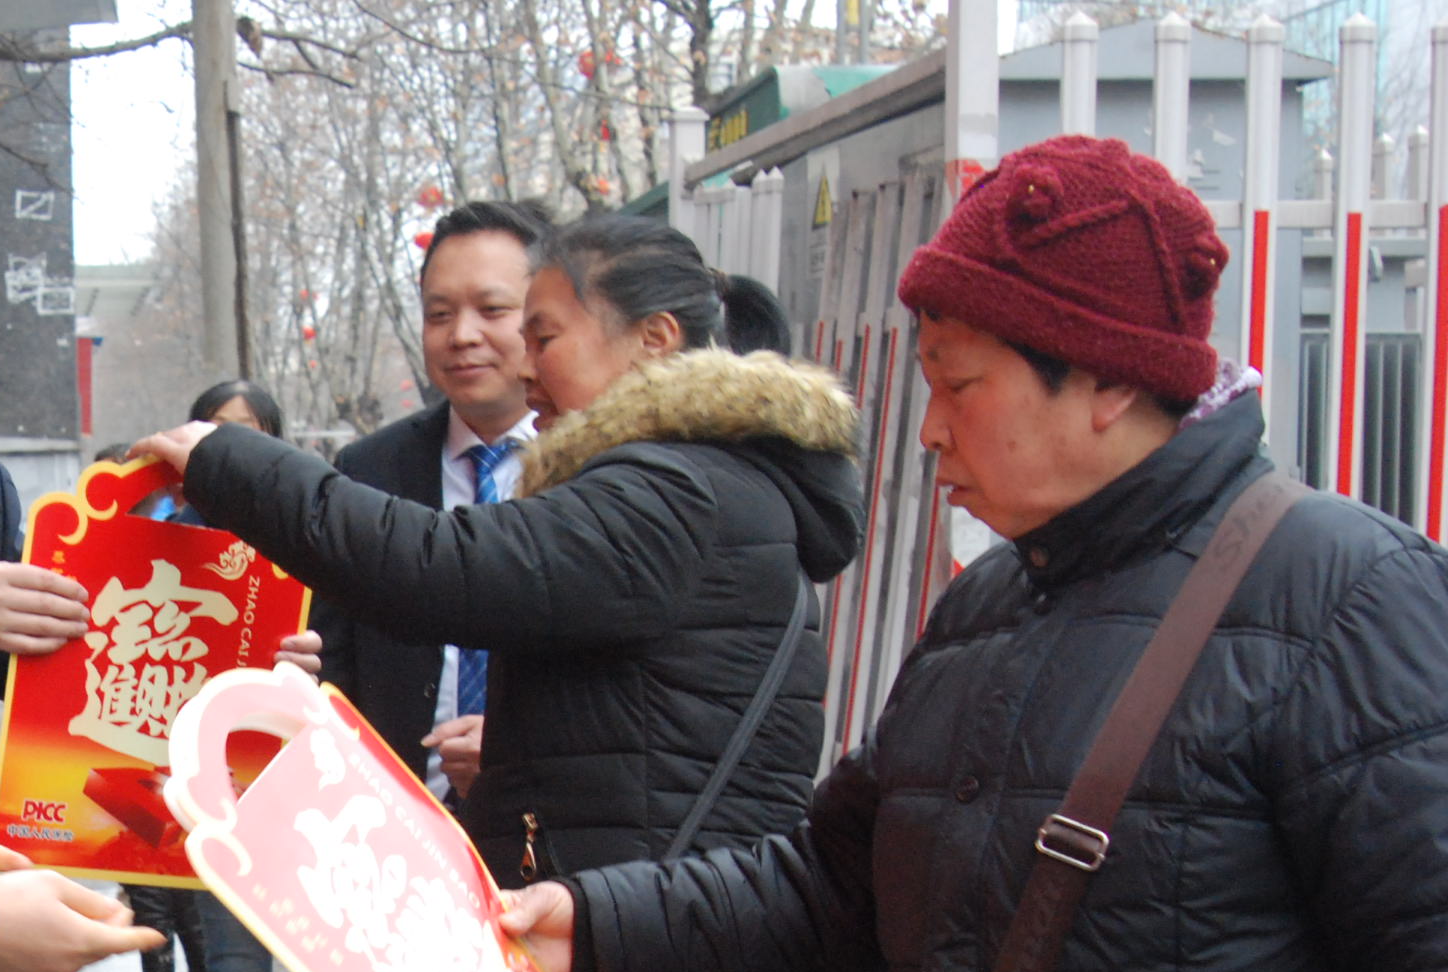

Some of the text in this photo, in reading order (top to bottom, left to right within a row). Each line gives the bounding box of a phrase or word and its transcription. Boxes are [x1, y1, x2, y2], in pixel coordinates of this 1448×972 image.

[243, 574, 260, 625] ZHAO
[237, 627, 252, 657] CAI
[22, 799, 67, 823] PICC
